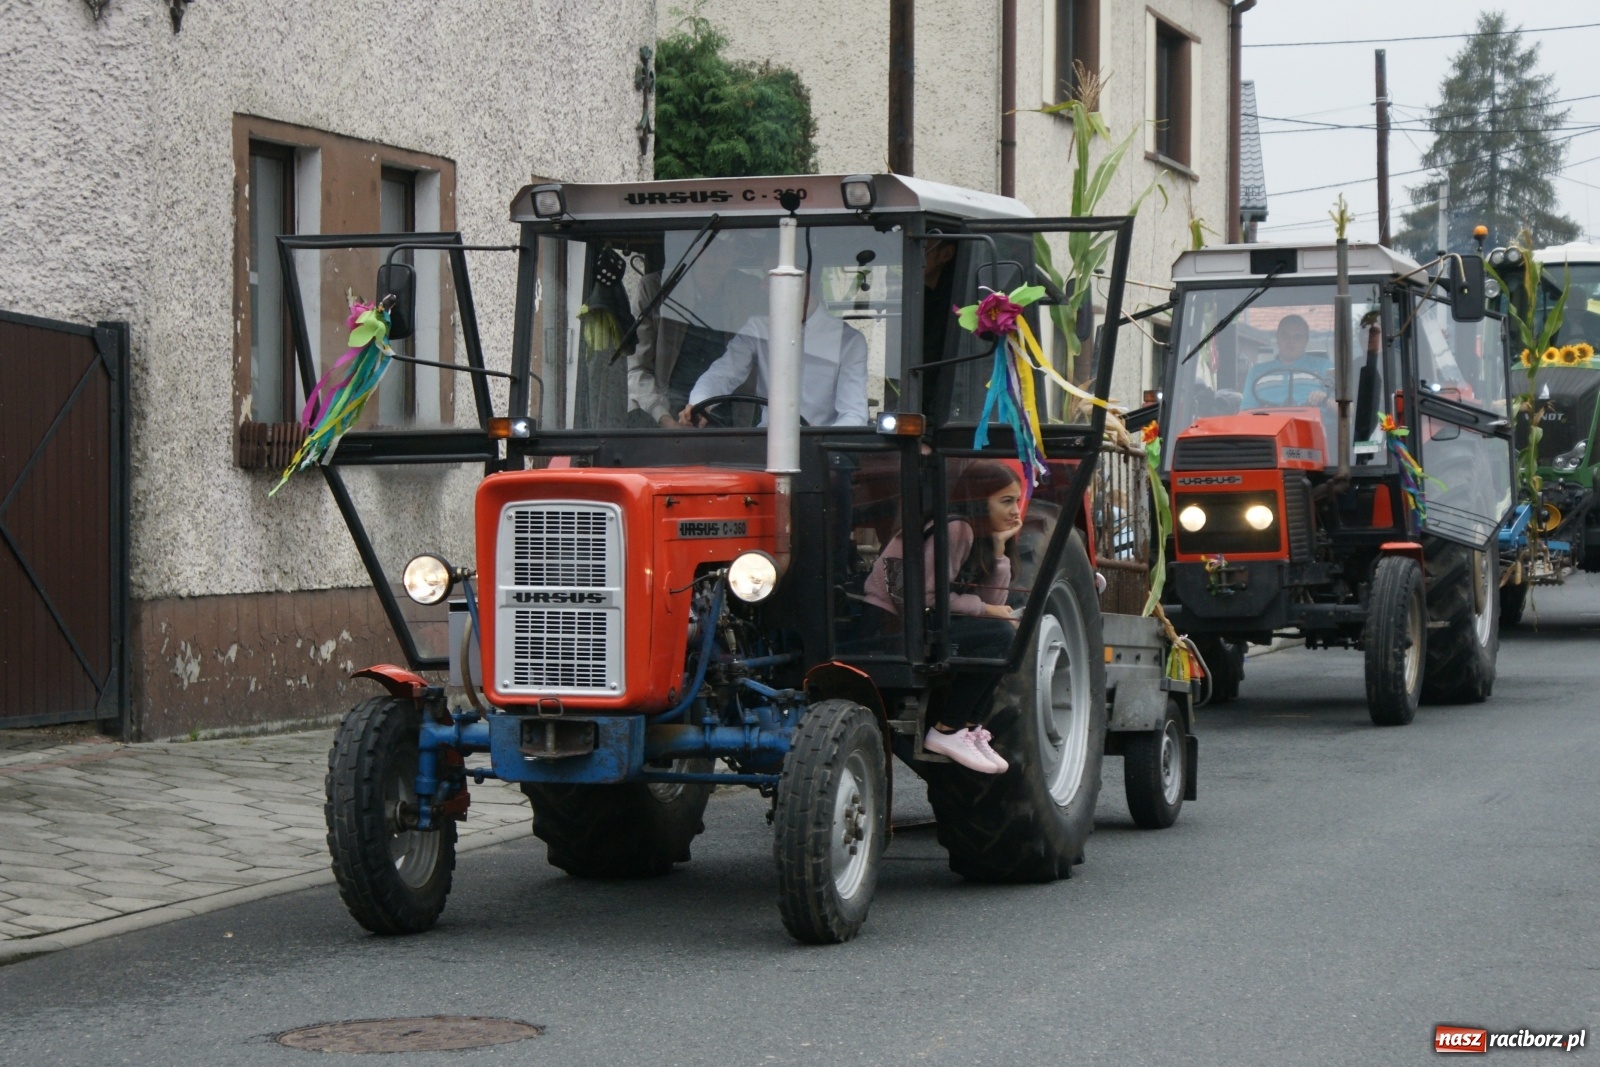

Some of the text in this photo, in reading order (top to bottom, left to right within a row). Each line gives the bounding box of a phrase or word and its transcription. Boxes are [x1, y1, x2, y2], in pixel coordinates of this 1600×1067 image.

[624, 190, 733, 205] URSUS
[1178, 476, 1241, 485] URSUS
[680, 522, 720, 536] URSUS
[512, 592, 607, 604] URSUS
